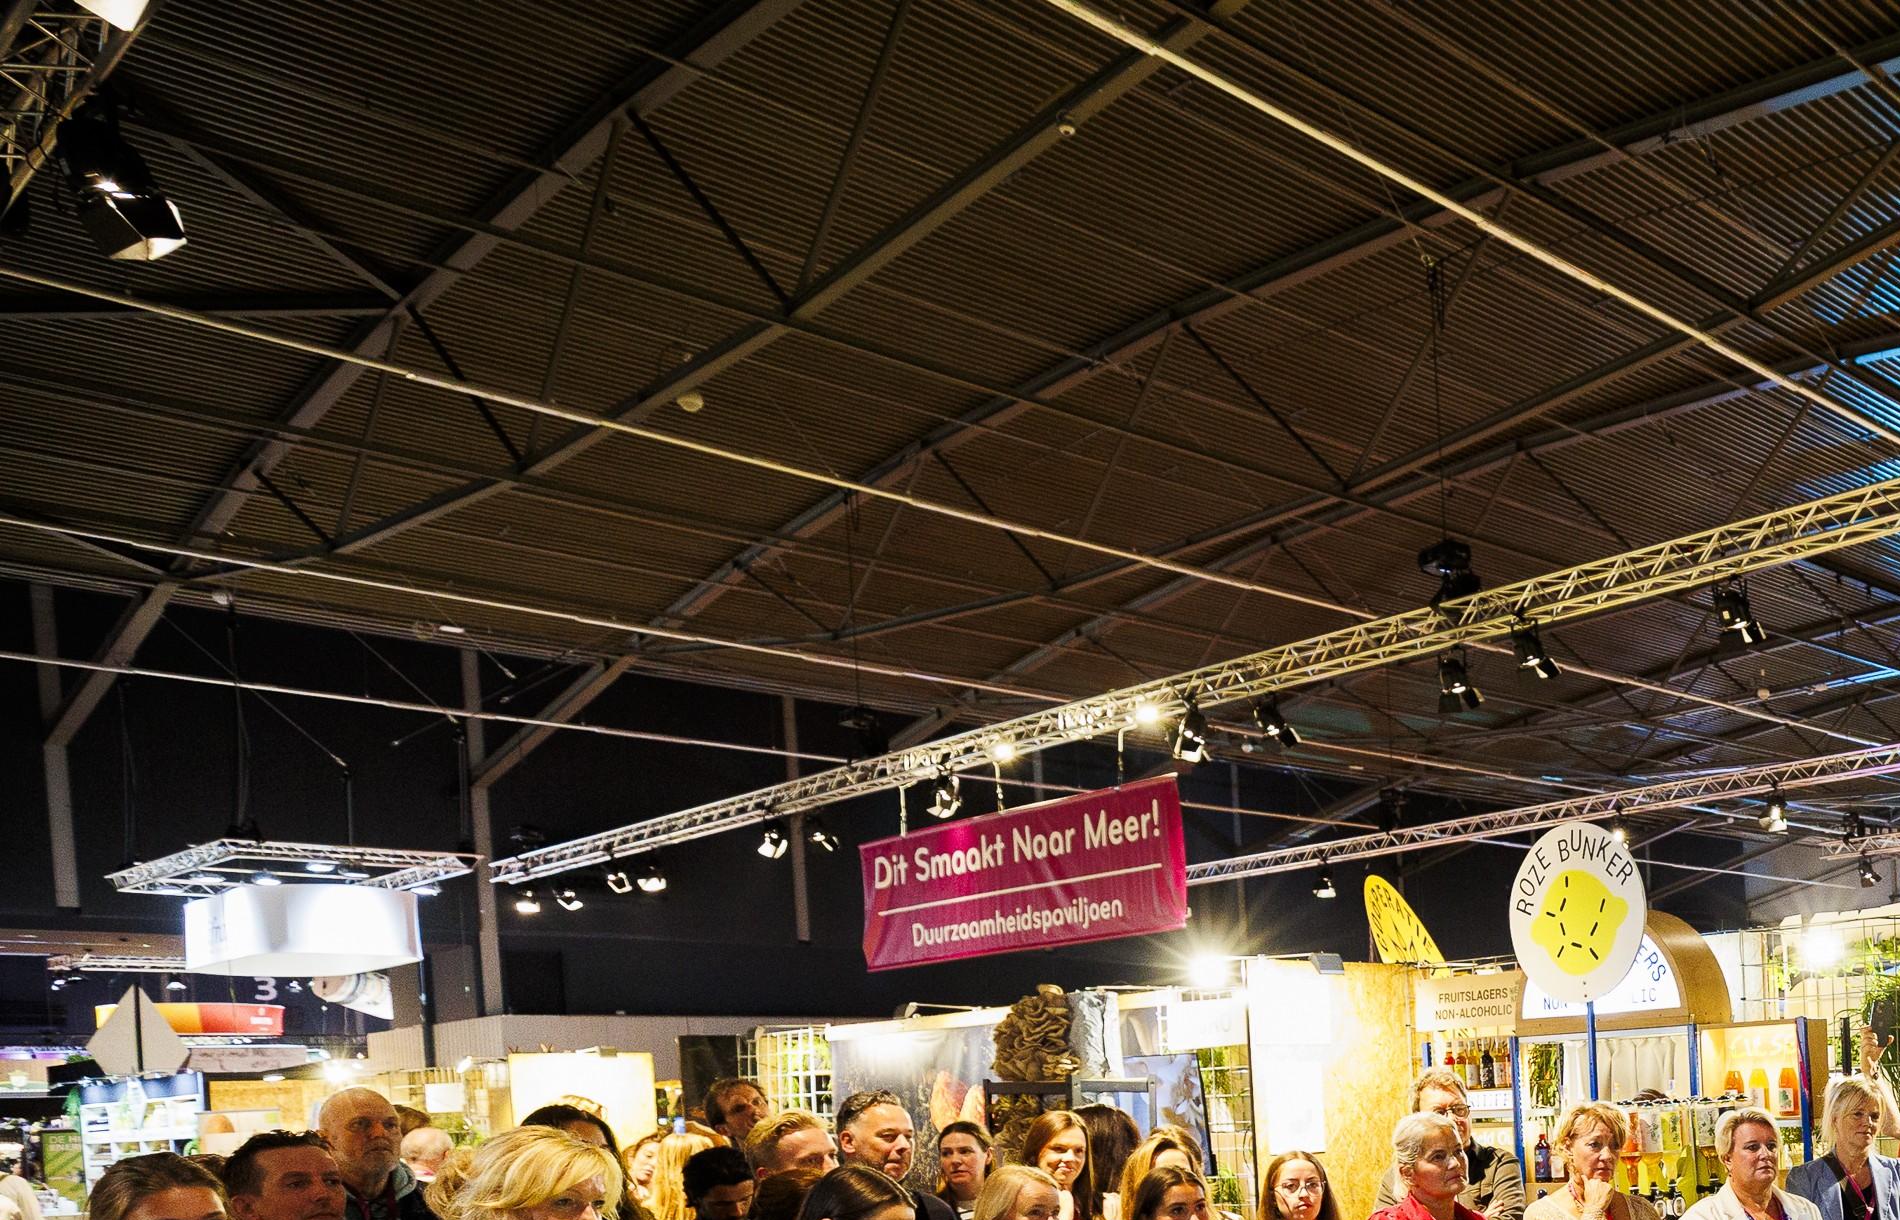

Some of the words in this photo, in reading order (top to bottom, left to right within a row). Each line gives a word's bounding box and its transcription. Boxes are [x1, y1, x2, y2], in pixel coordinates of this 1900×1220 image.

[874, 855, 909, 890] Dit
[914, 832, 1004, 882] Smaakt
[1011, 824, 1076, 864] Naar
[1083, 798, 1161, 850] Meer!
[1516, 847, 1552, 917] ROZE
[1557, 828, 1635, 886] BUNKER
[911, 895, 1123, 948] Duurzaamheidspaviljoen
[254, 976, 278, 1001] 3
[1438, 987, 1509, 1004] FRUITSLAGERS
[1435, 1004, 1513, 1020] NON-ALCOHOLIC
